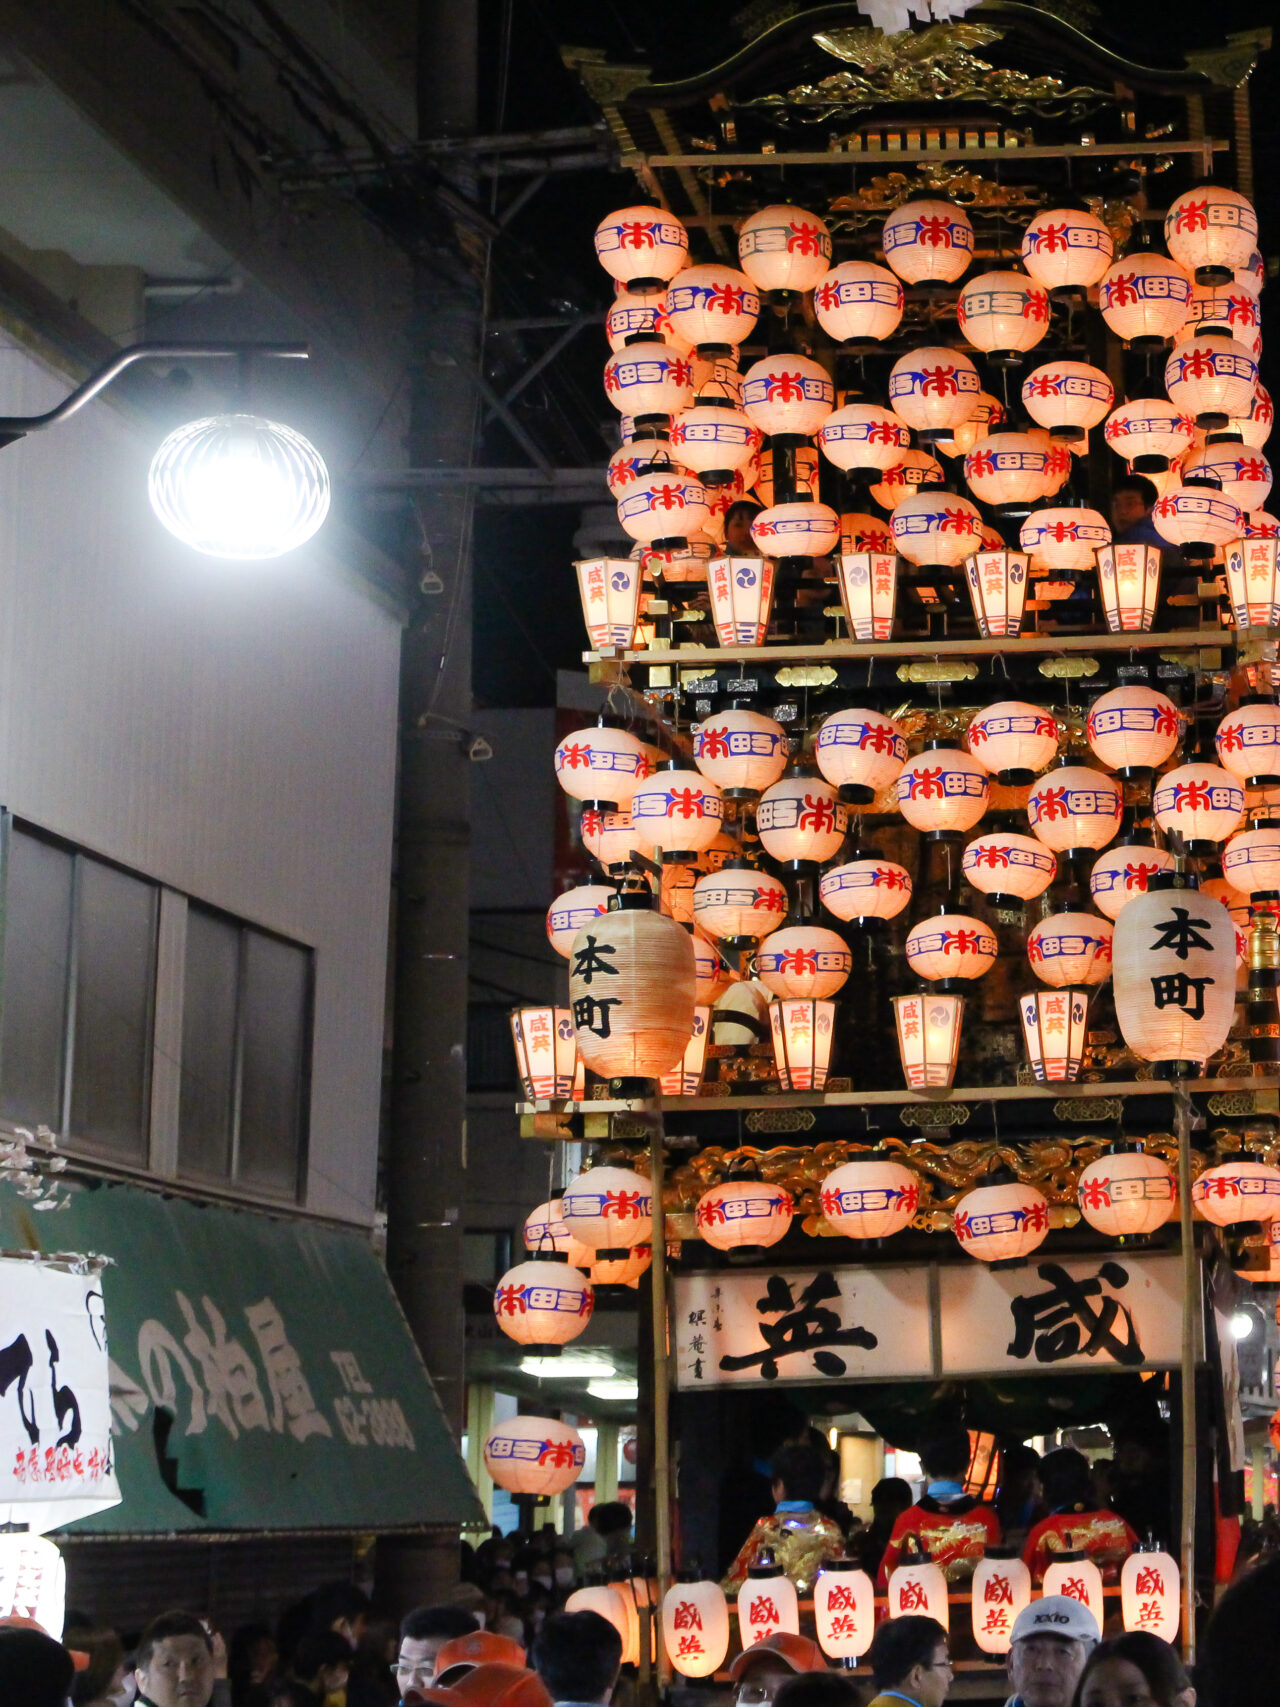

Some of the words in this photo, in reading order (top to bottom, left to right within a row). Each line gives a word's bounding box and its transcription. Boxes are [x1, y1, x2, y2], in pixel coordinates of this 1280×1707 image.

[571, 935, 623, 1039] 本町
[1150, 907, 1215, 1021] 本町
[827, 1585, 858, 1640] 咸英
[981, 1573, 1013, 1634] 咸英
[1034, 1611, 1070, 1624] XXIO
[1135, 1566, 1164, 1628] 咸英
[674, 1601, 704, 1660] 咸英
